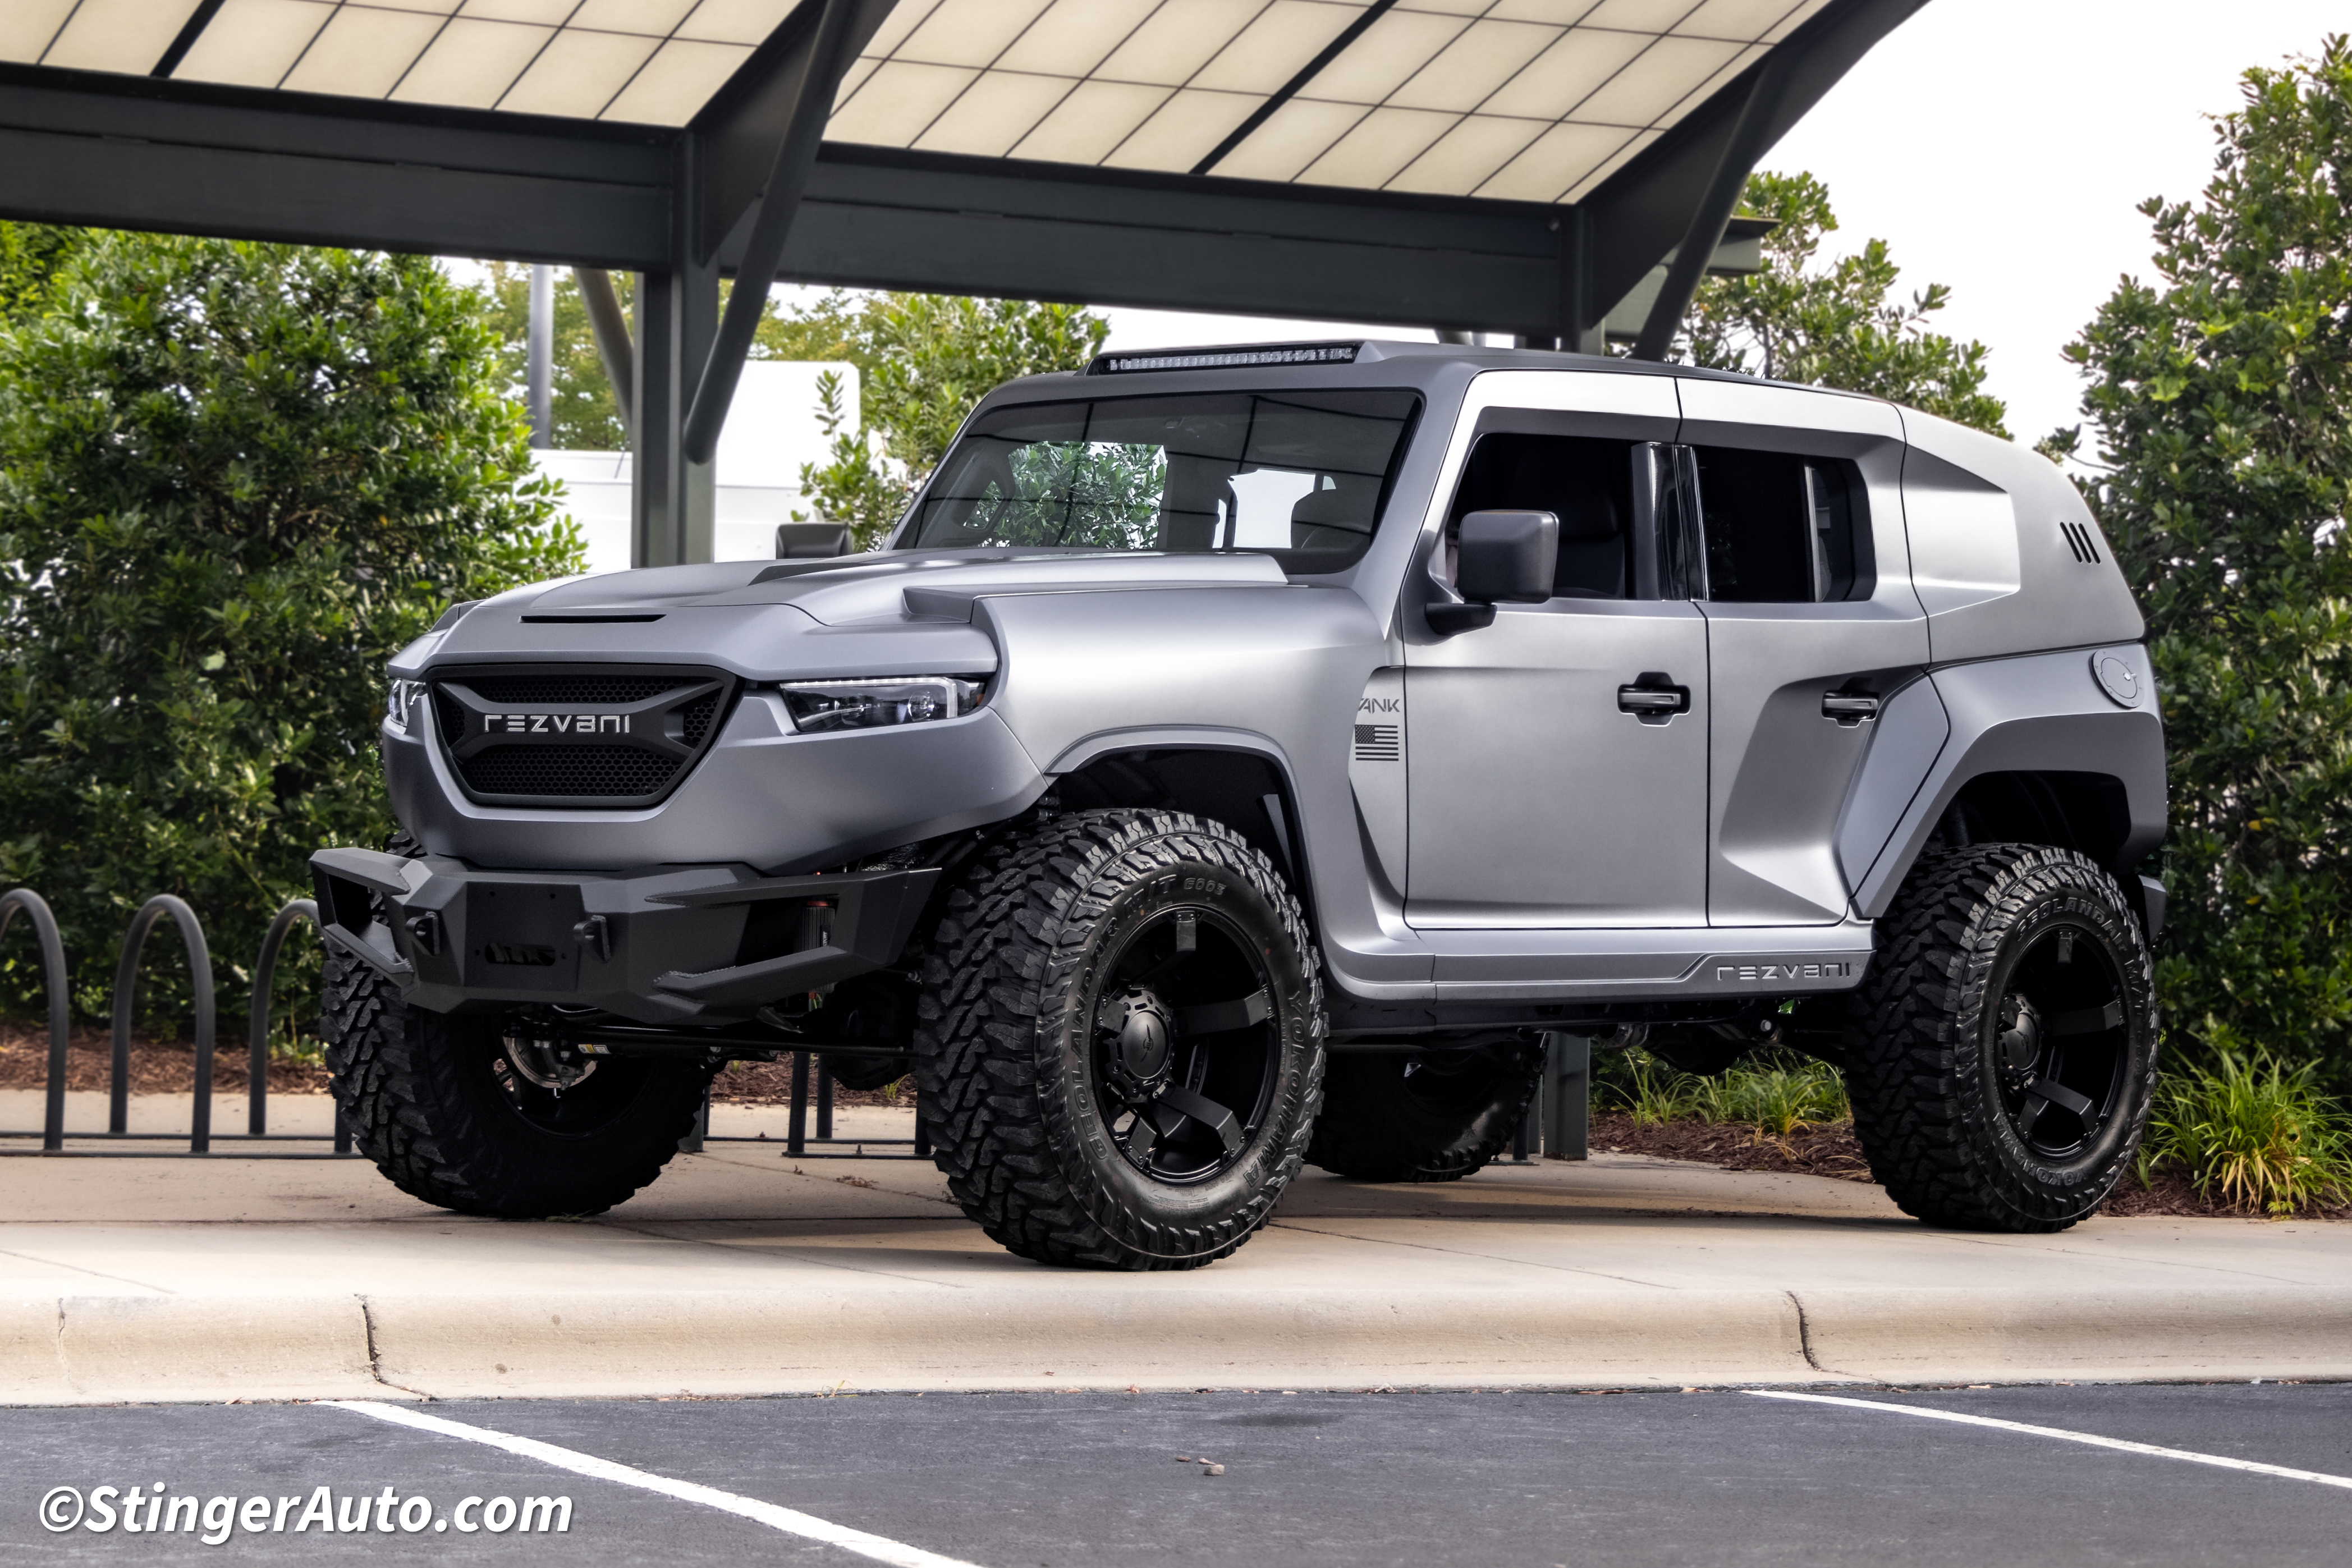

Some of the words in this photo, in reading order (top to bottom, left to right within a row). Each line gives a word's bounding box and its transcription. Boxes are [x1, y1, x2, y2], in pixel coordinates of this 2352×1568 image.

[1124, 873, 1177, 919] M/T
[1184, 877, 1227, 896] G003
[1243, 990, 1305, 1188] YOKOHAMA
